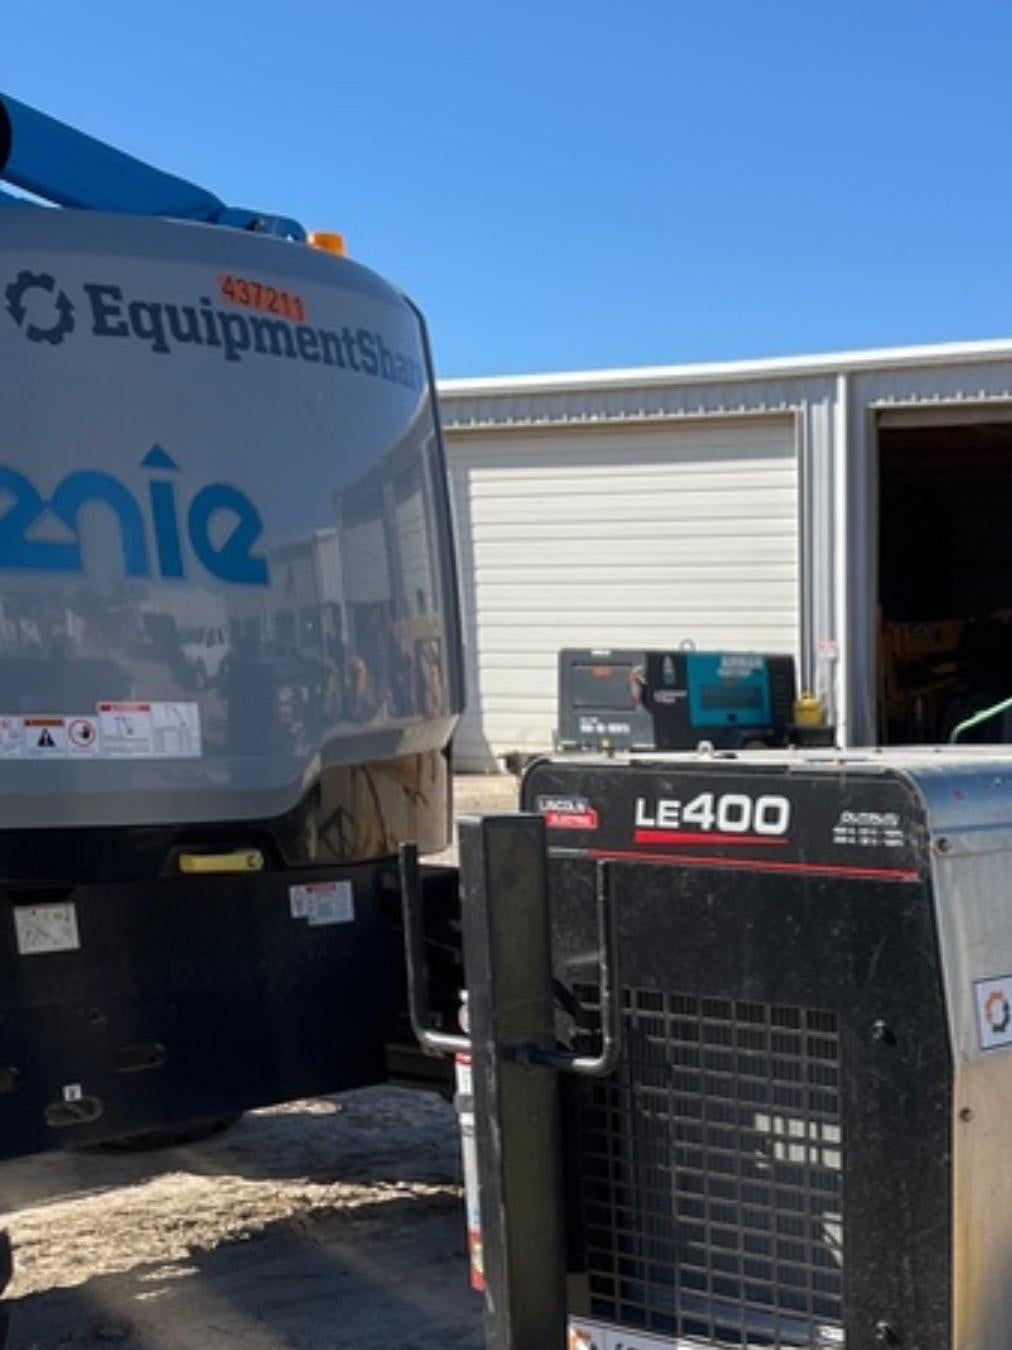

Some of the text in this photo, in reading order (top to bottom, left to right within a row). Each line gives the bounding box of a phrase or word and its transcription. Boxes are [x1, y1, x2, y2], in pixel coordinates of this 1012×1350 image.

[221, 275, 304, 322] 437211
[83, 284, 418, 387] EquipmentShar
[635, 793, 790, 835] LE400
